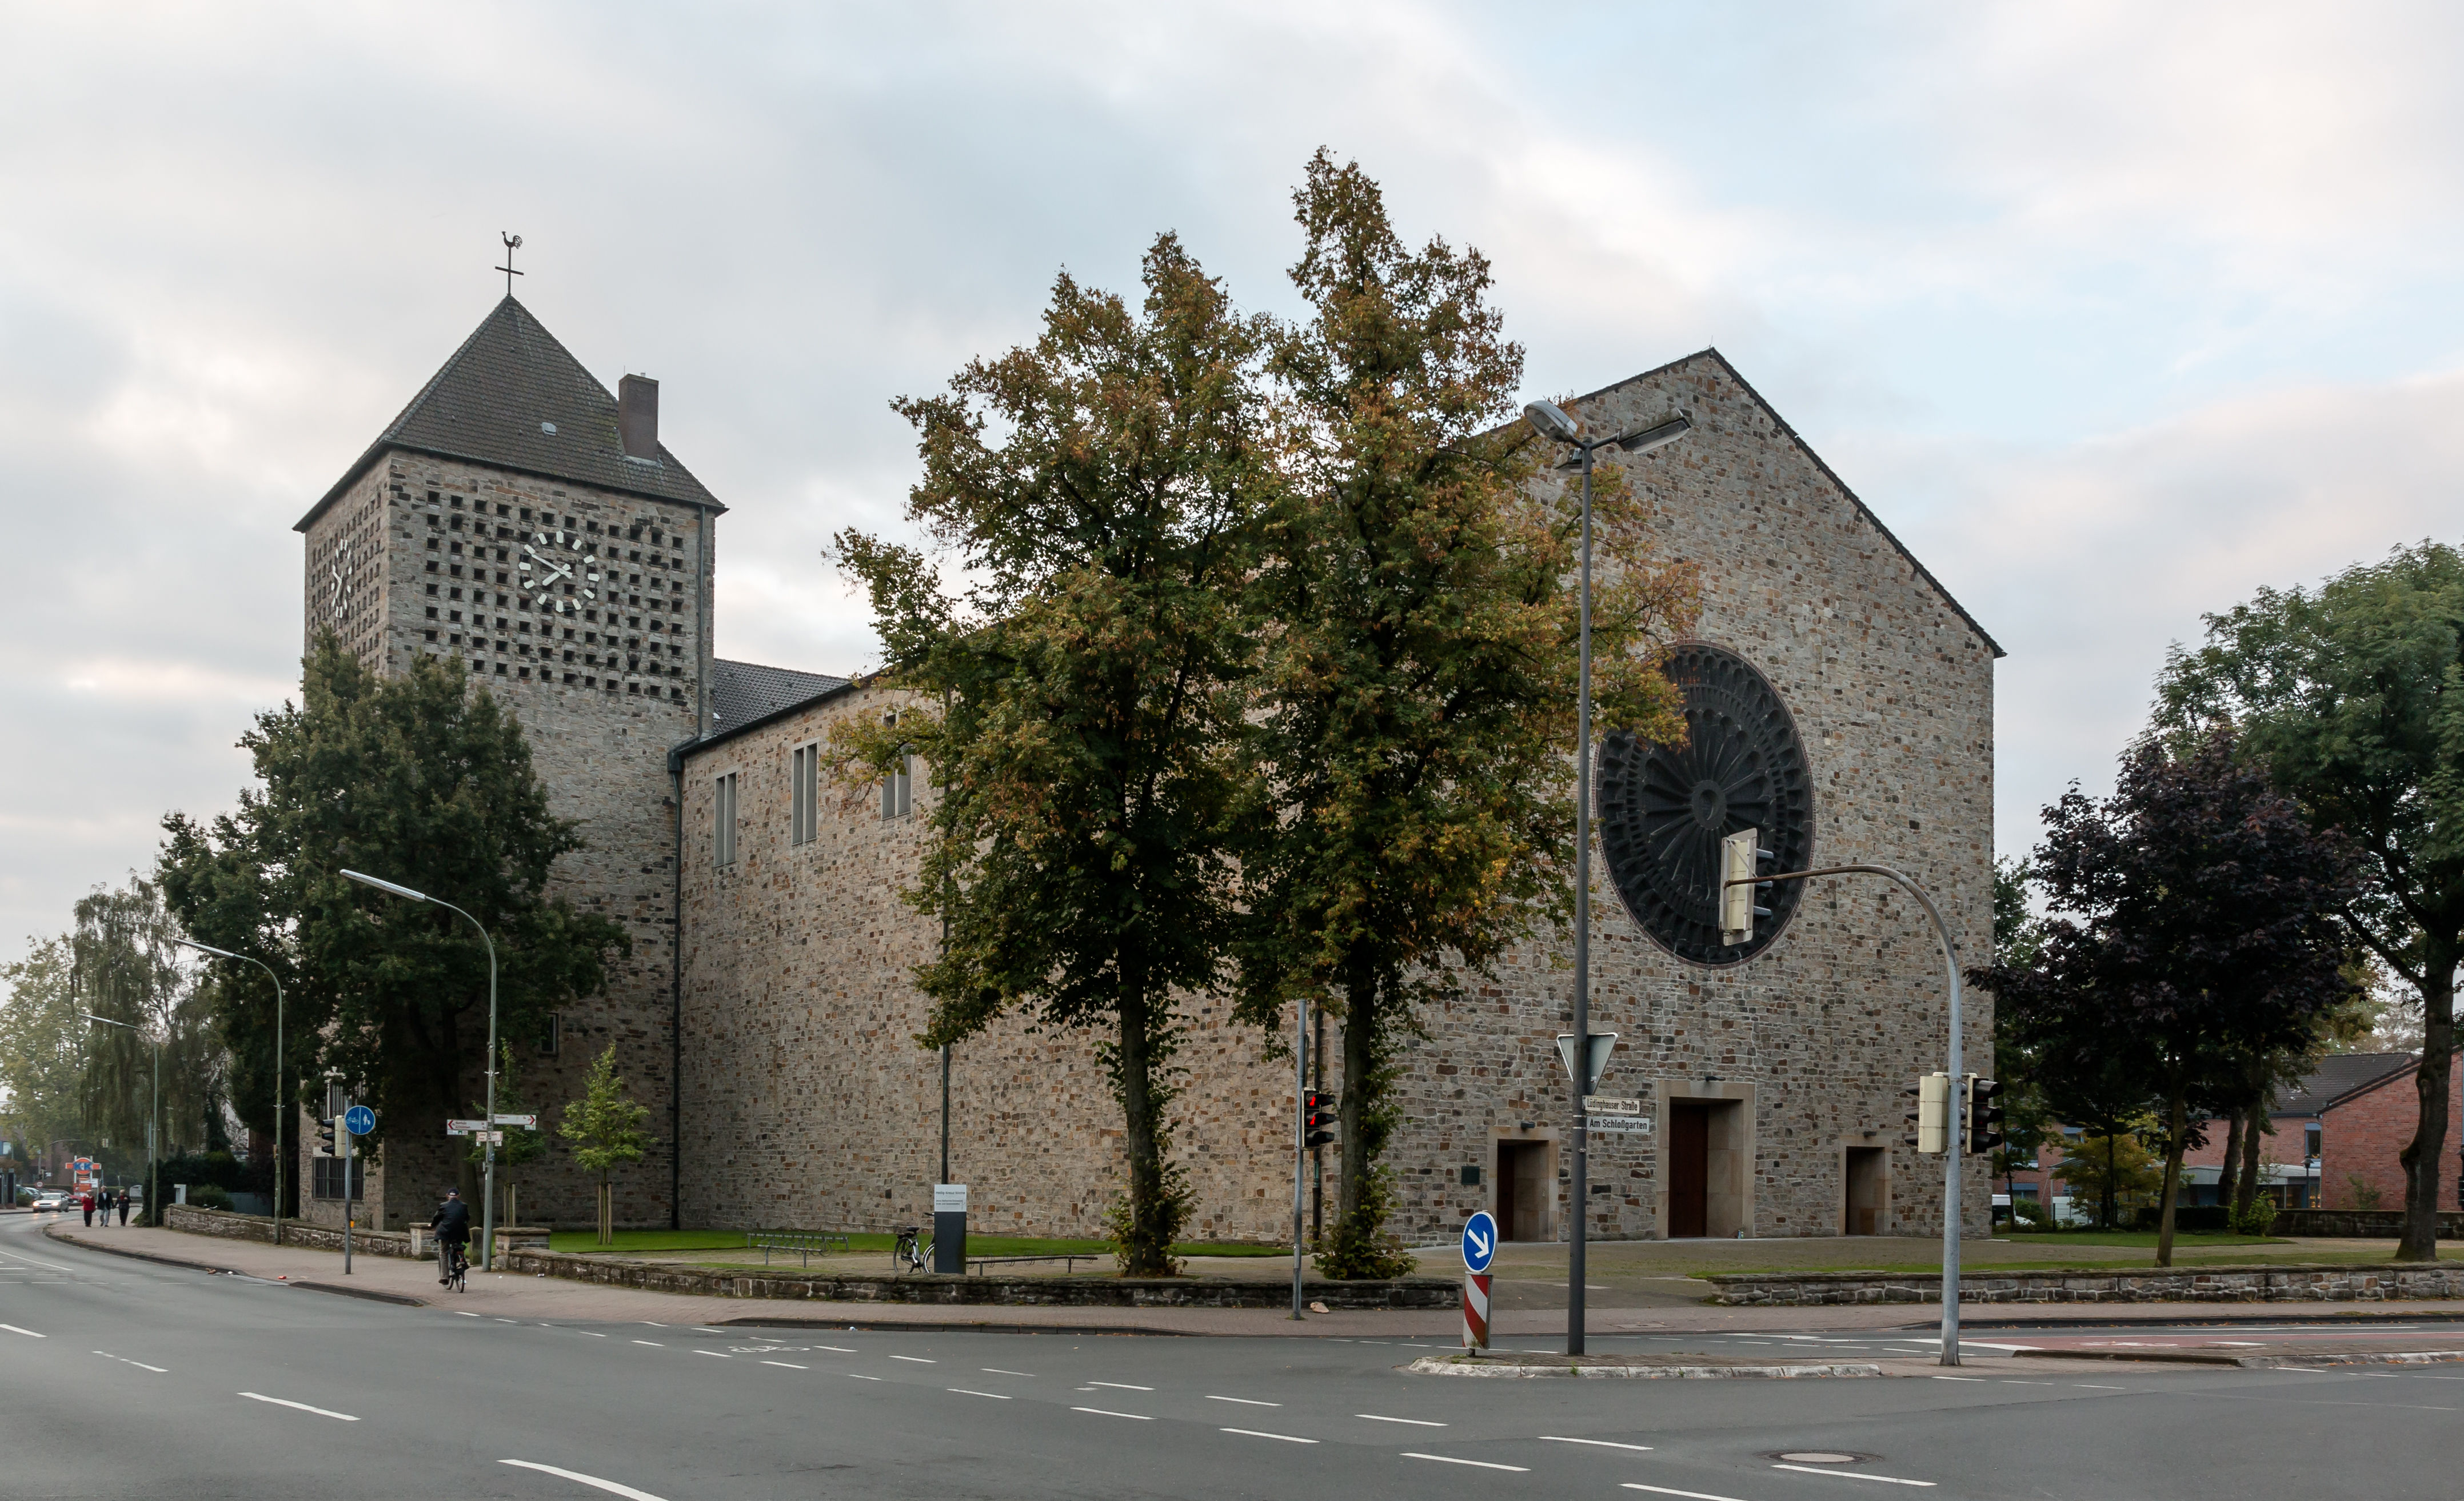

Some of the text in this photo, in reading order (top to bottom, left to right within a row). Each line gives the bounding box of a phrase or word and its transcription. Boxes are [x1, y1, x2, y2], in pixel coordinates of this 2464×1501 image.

[1587, 1098, 1638, 1111] Lüdinghauser Straße
[1590, 1118, 1647, 1131] Am Schloßgarten
